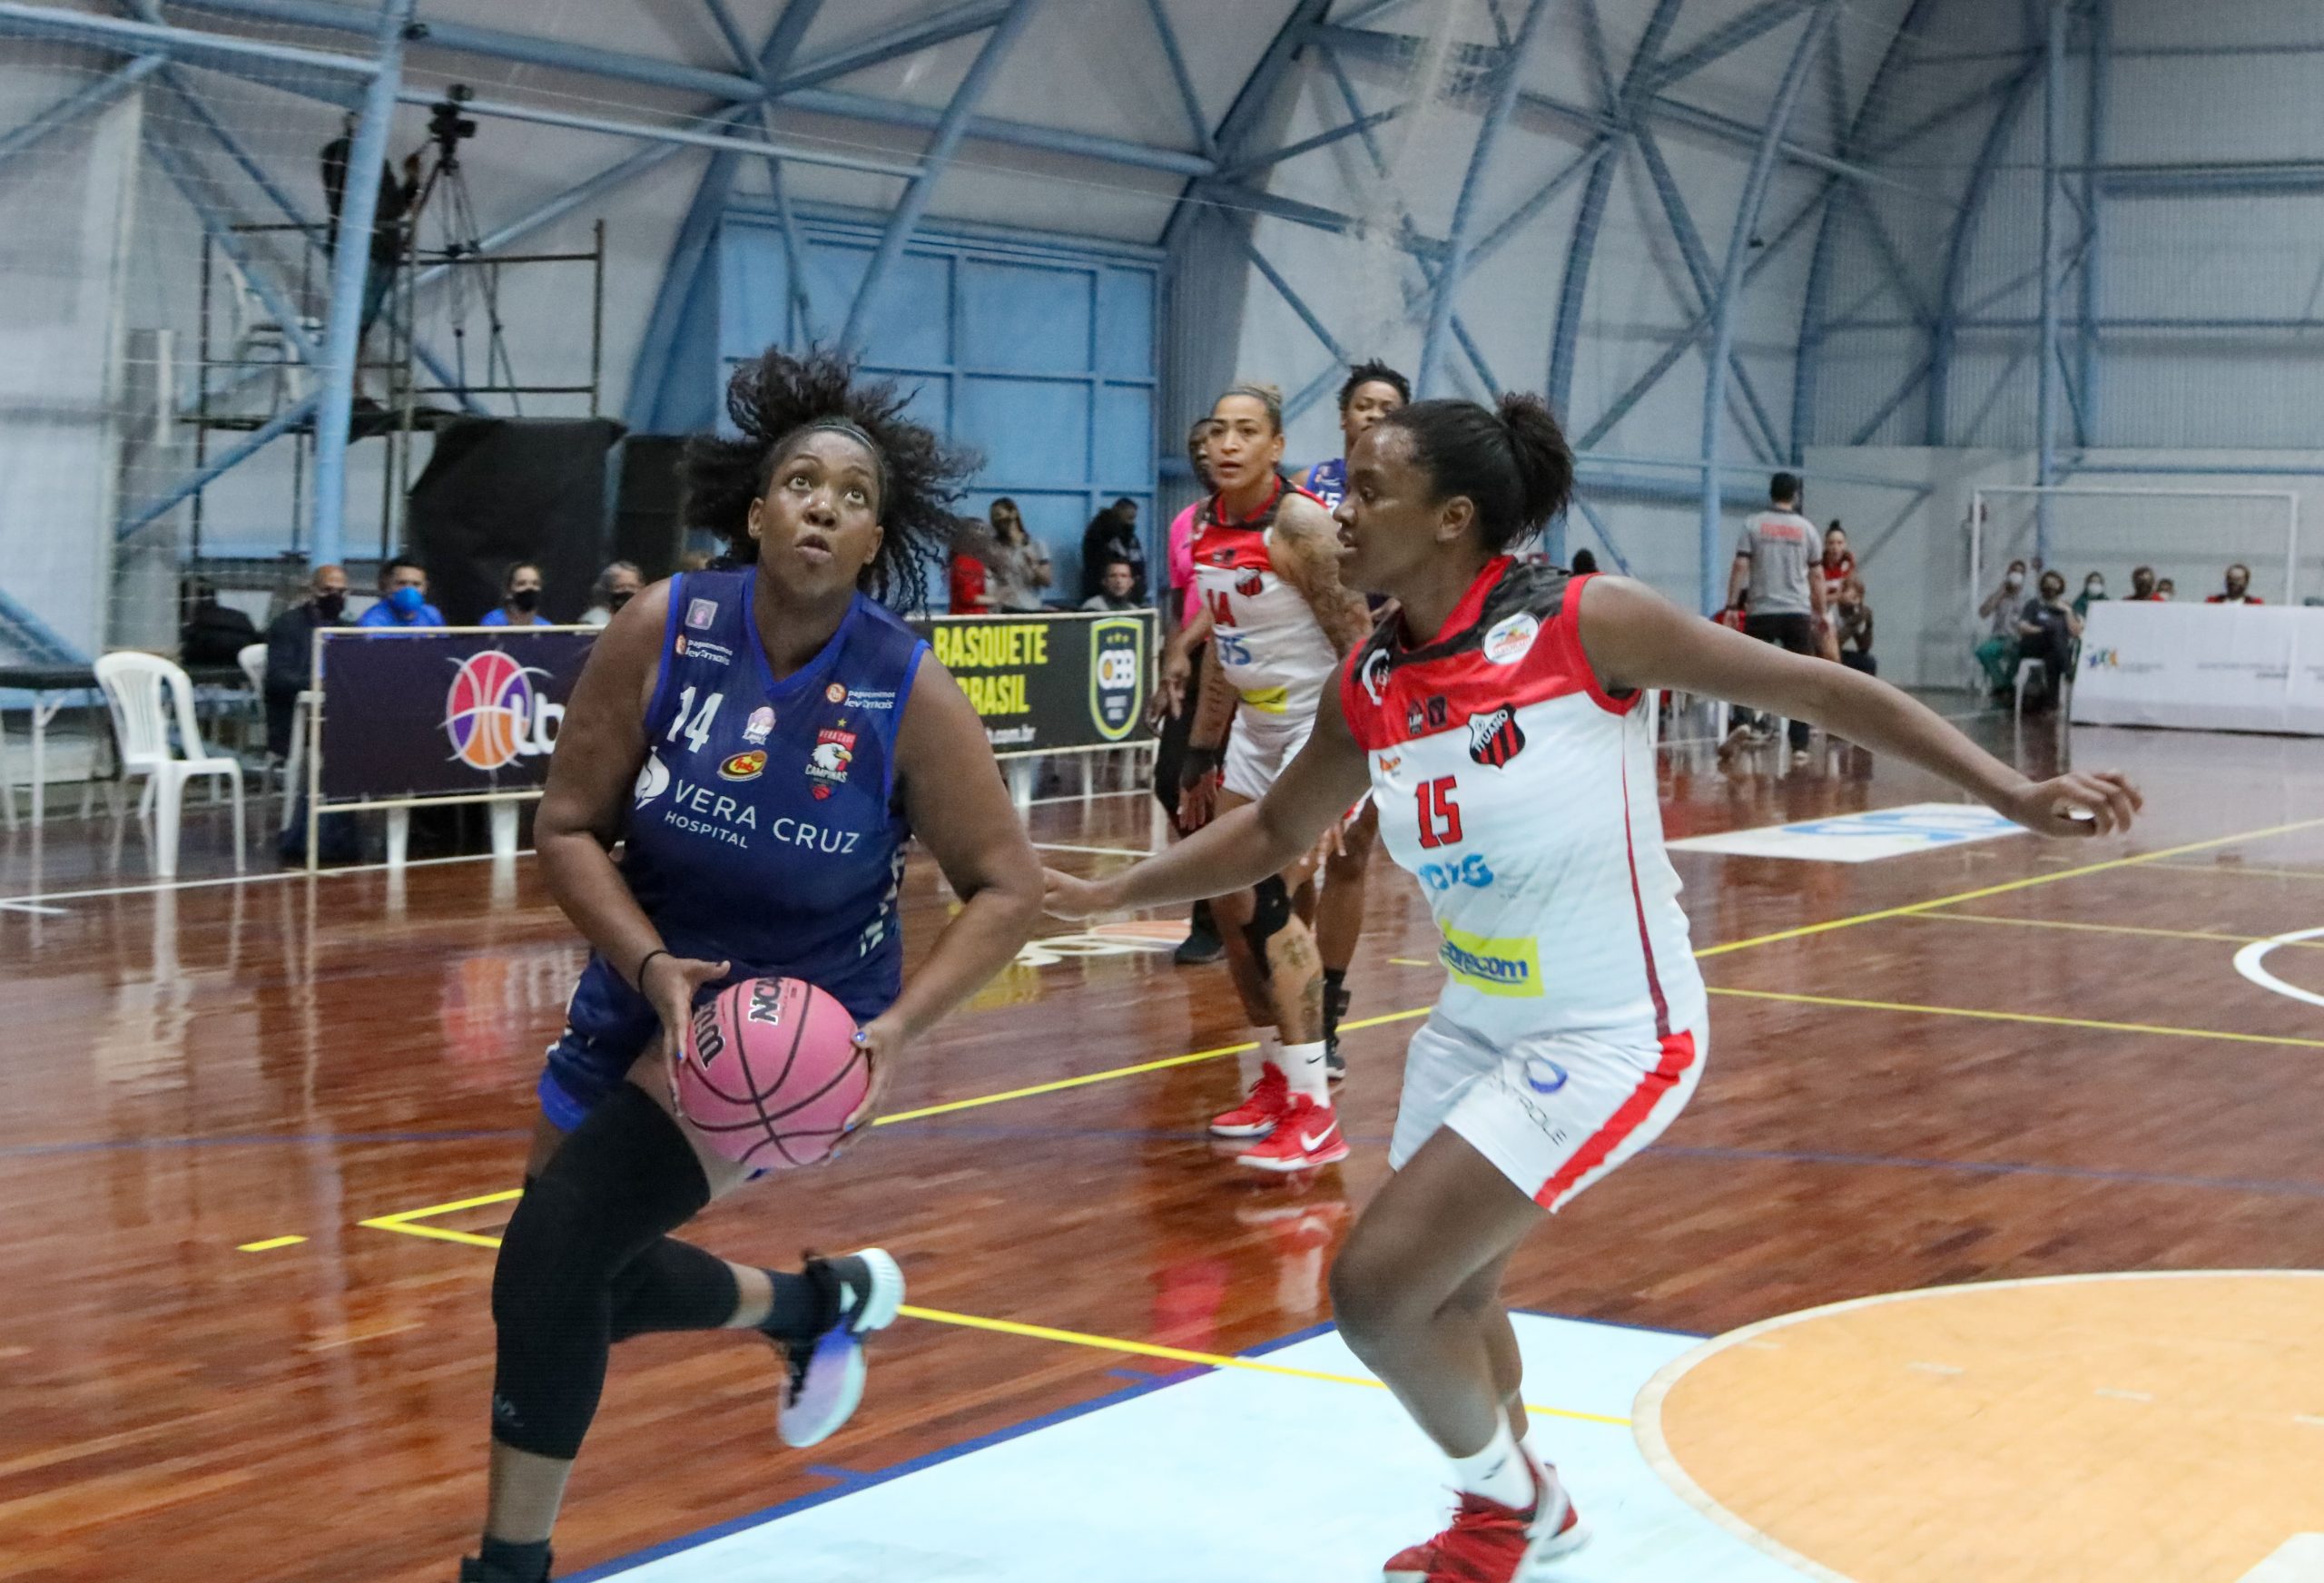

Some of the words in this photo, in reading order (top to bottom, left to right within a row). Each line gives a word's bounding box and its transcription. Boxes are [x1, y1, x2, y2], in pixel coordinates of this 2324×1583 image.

[933, 624, 1049, 668] BASQUETE
[666, 686, 724, 753] 14
[664, 811, 749, 850] HOSPITAL
[674, 779, 757, 830] VERA
[772, 817, 861, 854] CRUZ
[1414, 774, 1463, 850] 15
